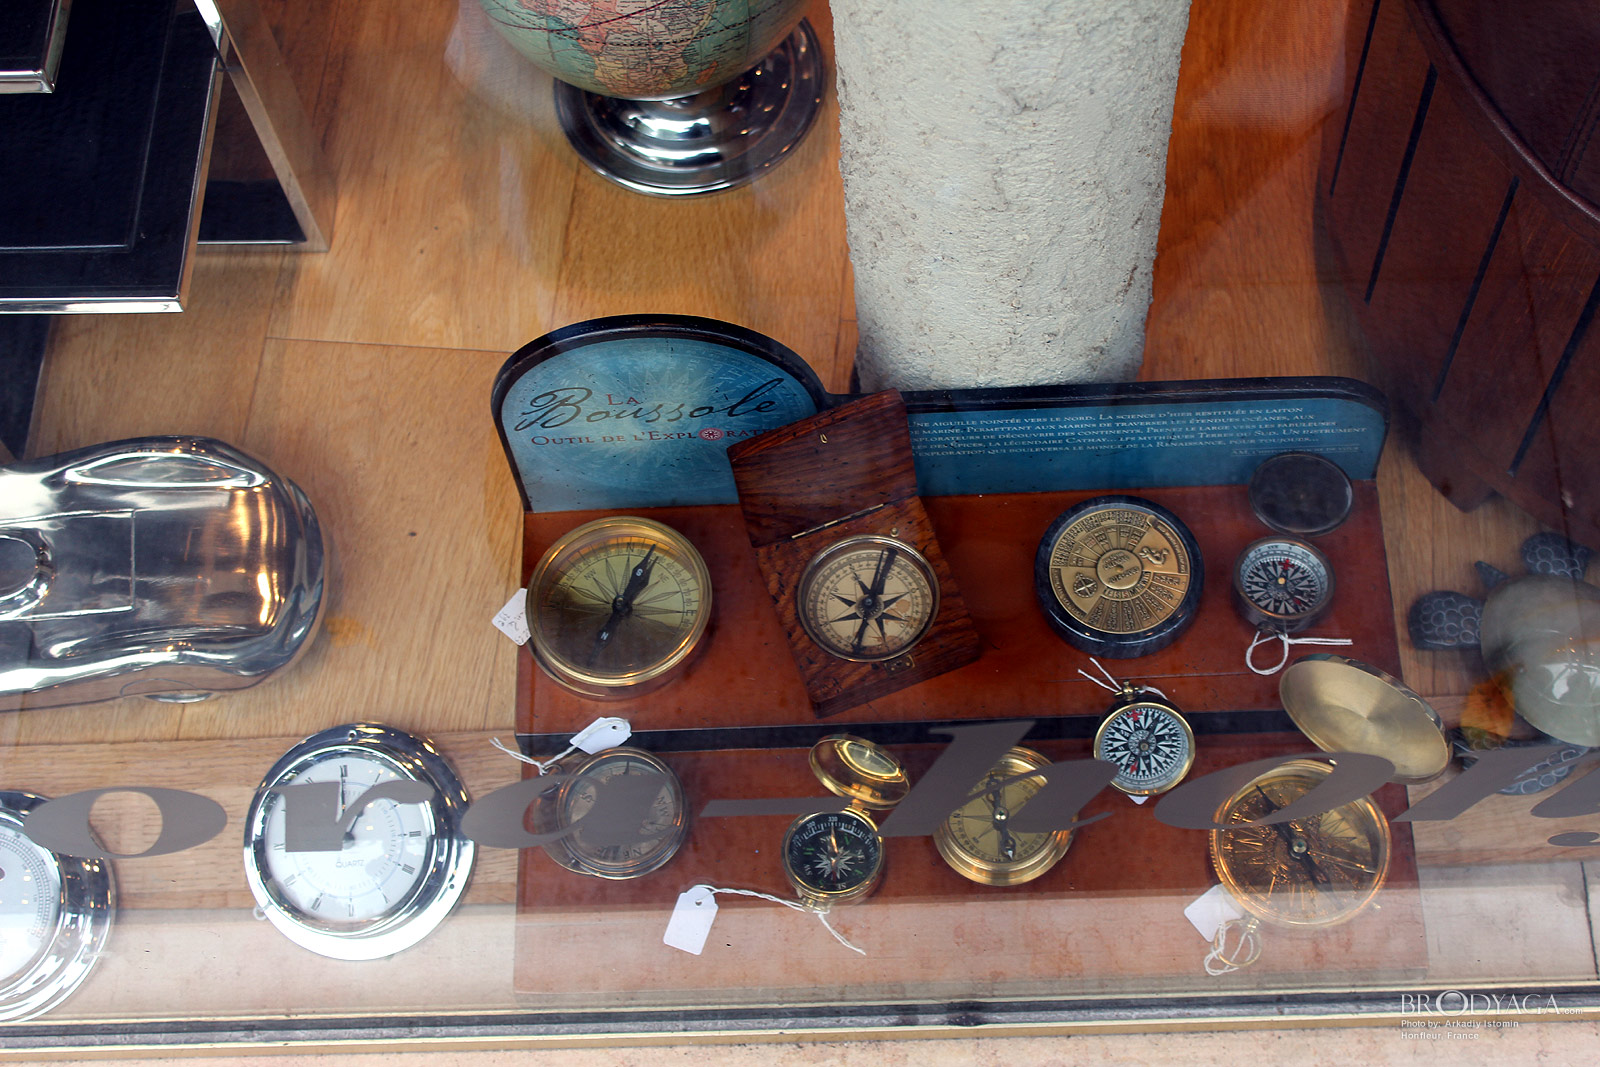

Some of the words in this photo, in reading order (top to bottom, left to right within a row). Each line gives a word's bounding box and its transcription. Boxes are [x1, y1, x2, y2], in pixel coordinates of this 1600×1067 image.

[514, 377, 785, 432] Boussole
[1003, 439, 1063, 447] LÉGENDAIRE
[636, 568, 643, 577] S
[600, 631, 609, 641] N
[335, 859, 365, 868] QUARTZ
